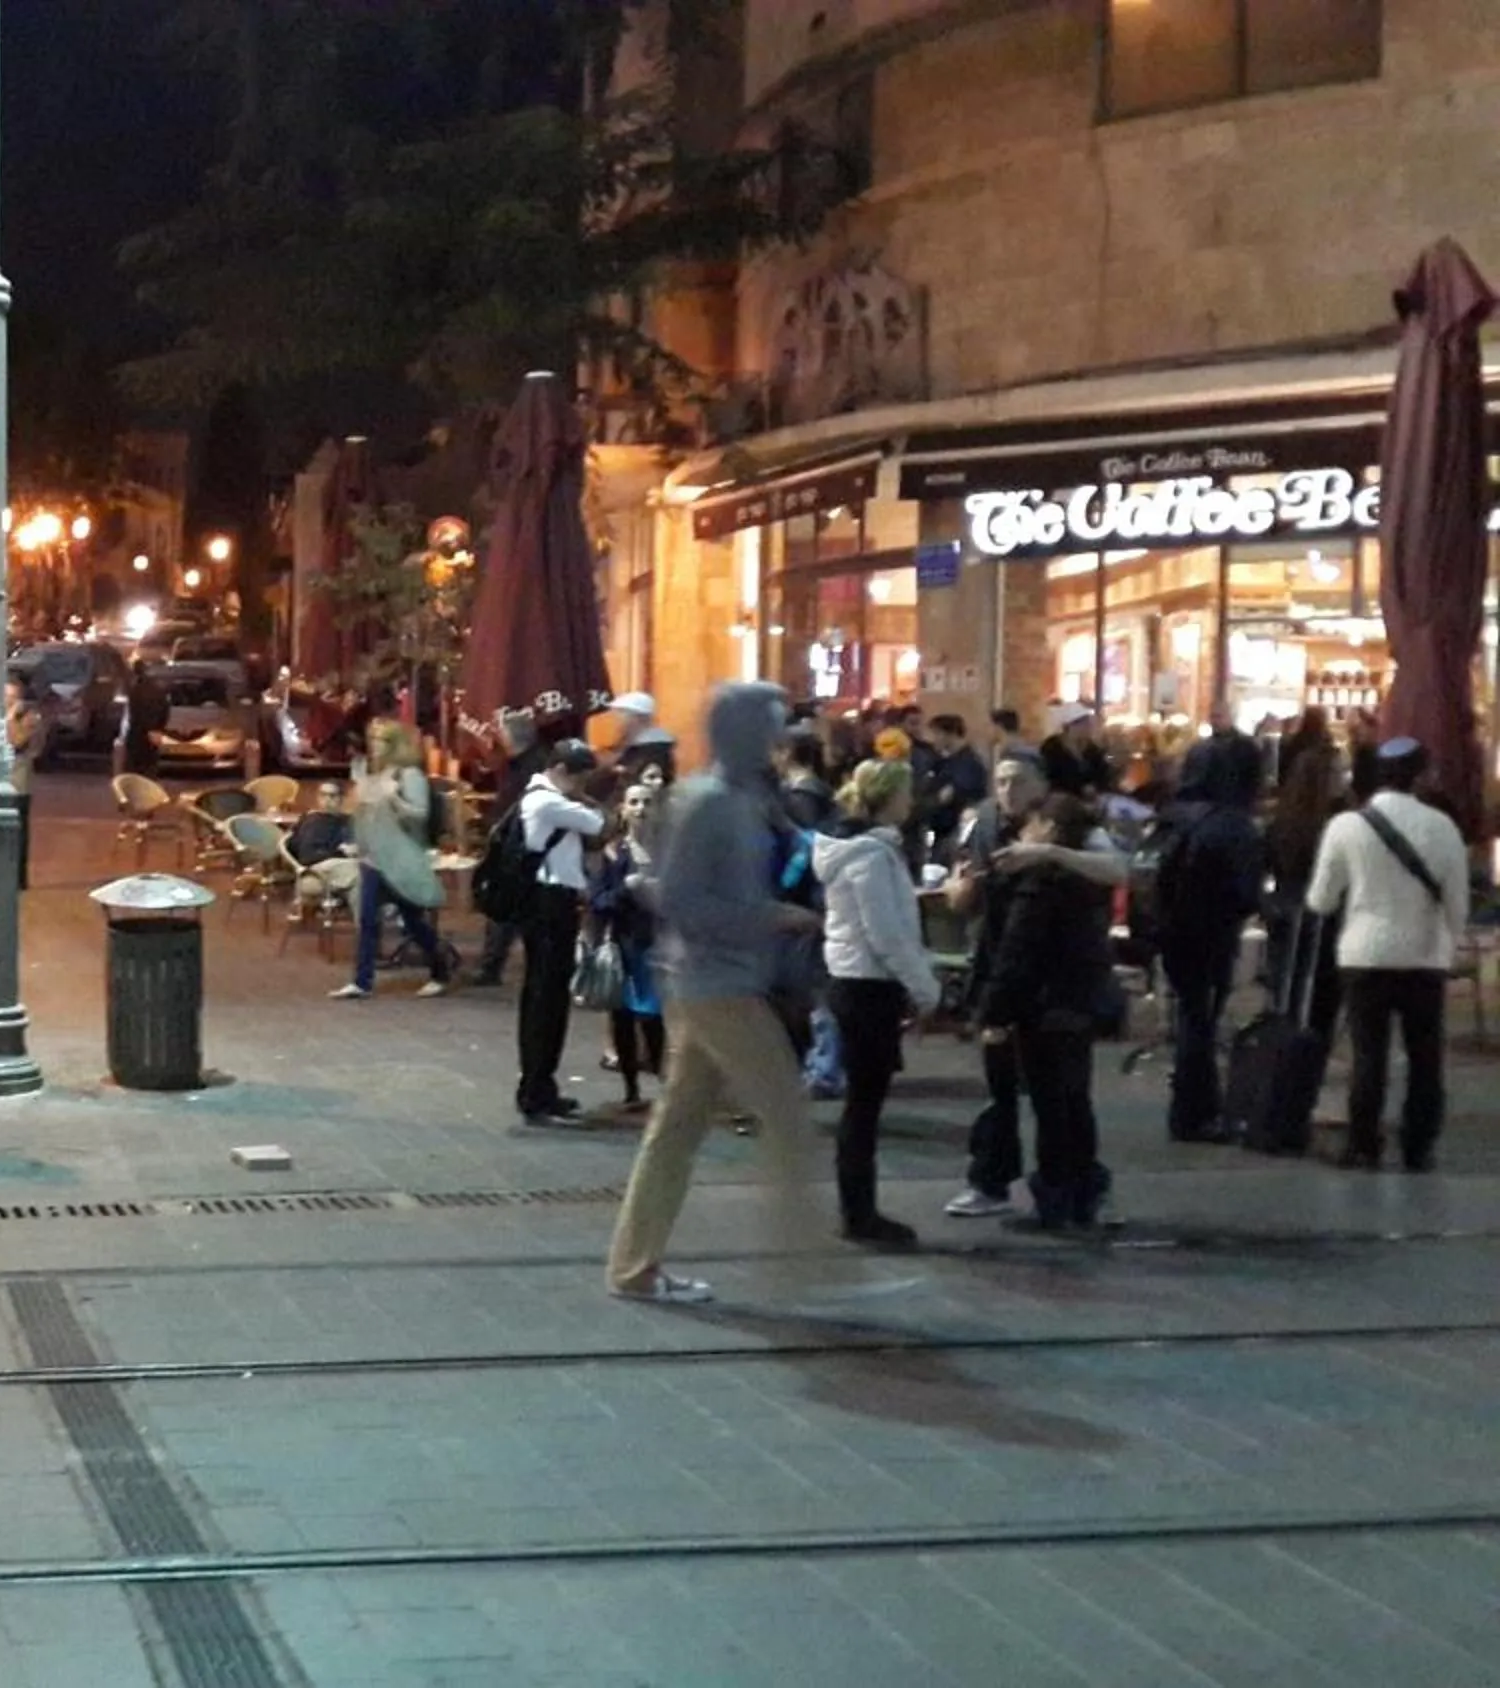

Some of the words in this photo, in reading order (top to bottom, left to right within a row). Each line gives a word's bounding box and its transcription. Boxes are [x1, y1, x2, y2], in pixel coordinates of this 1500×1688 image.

[965, 488, 1066, 555] The
[1067, 476, 1275, 540] Coffee
[1277, 467, 1381, 531] Be
